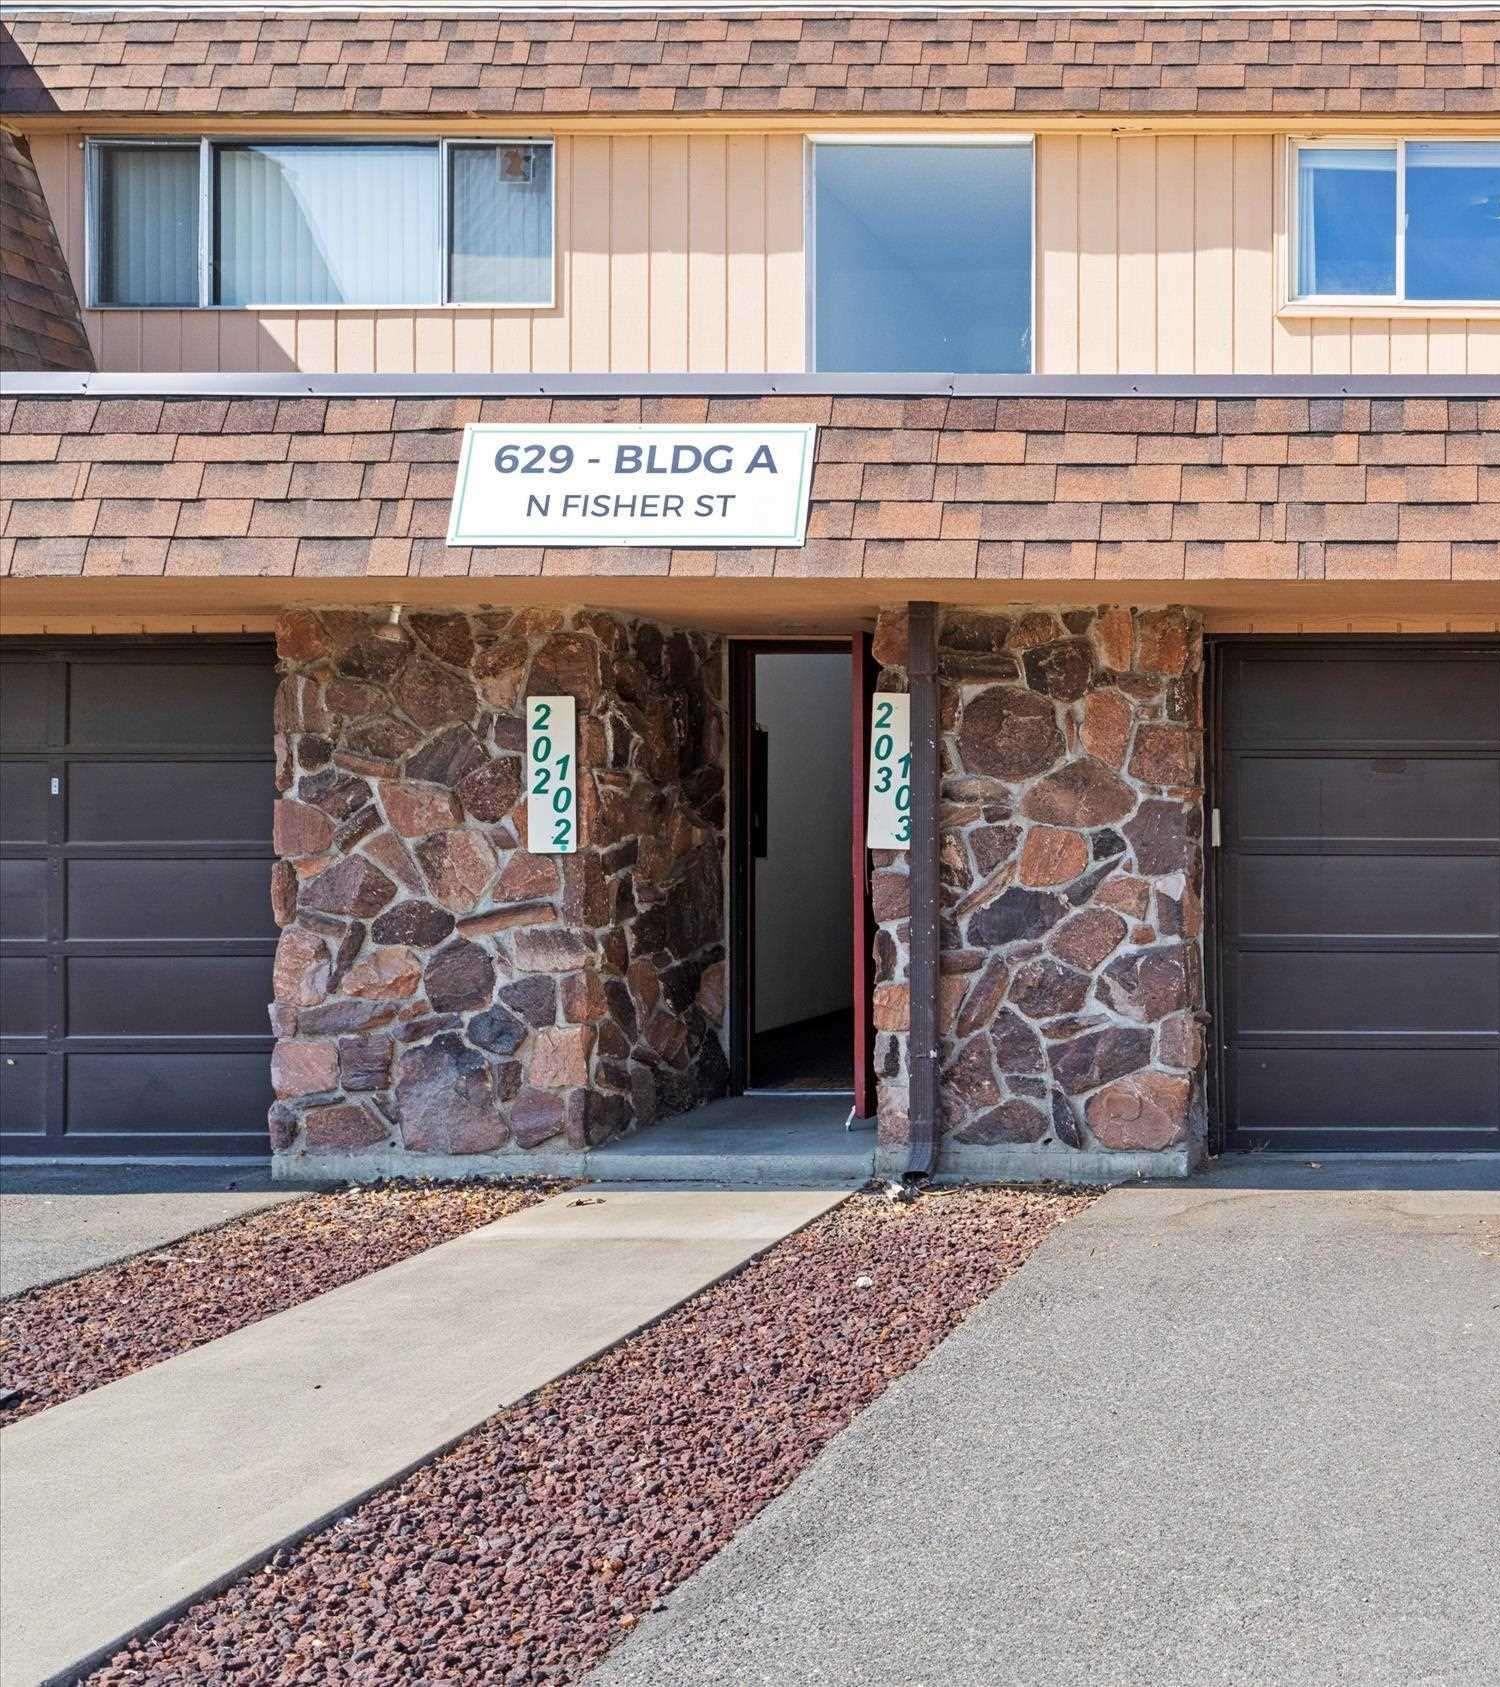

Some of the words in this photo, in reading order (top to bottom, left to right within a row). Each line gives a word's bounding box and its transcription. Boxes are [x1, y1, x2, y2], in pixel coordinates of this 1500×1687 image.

[494, 444, 574, 474] 629
[614, 444, 734, 474] BLDG
[745, 444, 778, 474] A
[526, 494, 550, 517] N
[562, 494, 682, 517] FISHER
[694, 494, 736, 517] ST
[532, 703, 552, 795] 202
[874, 702, 894, 793] 203
[552, 754, 572, 845] 102
[894, 752, 912, 842] 103
